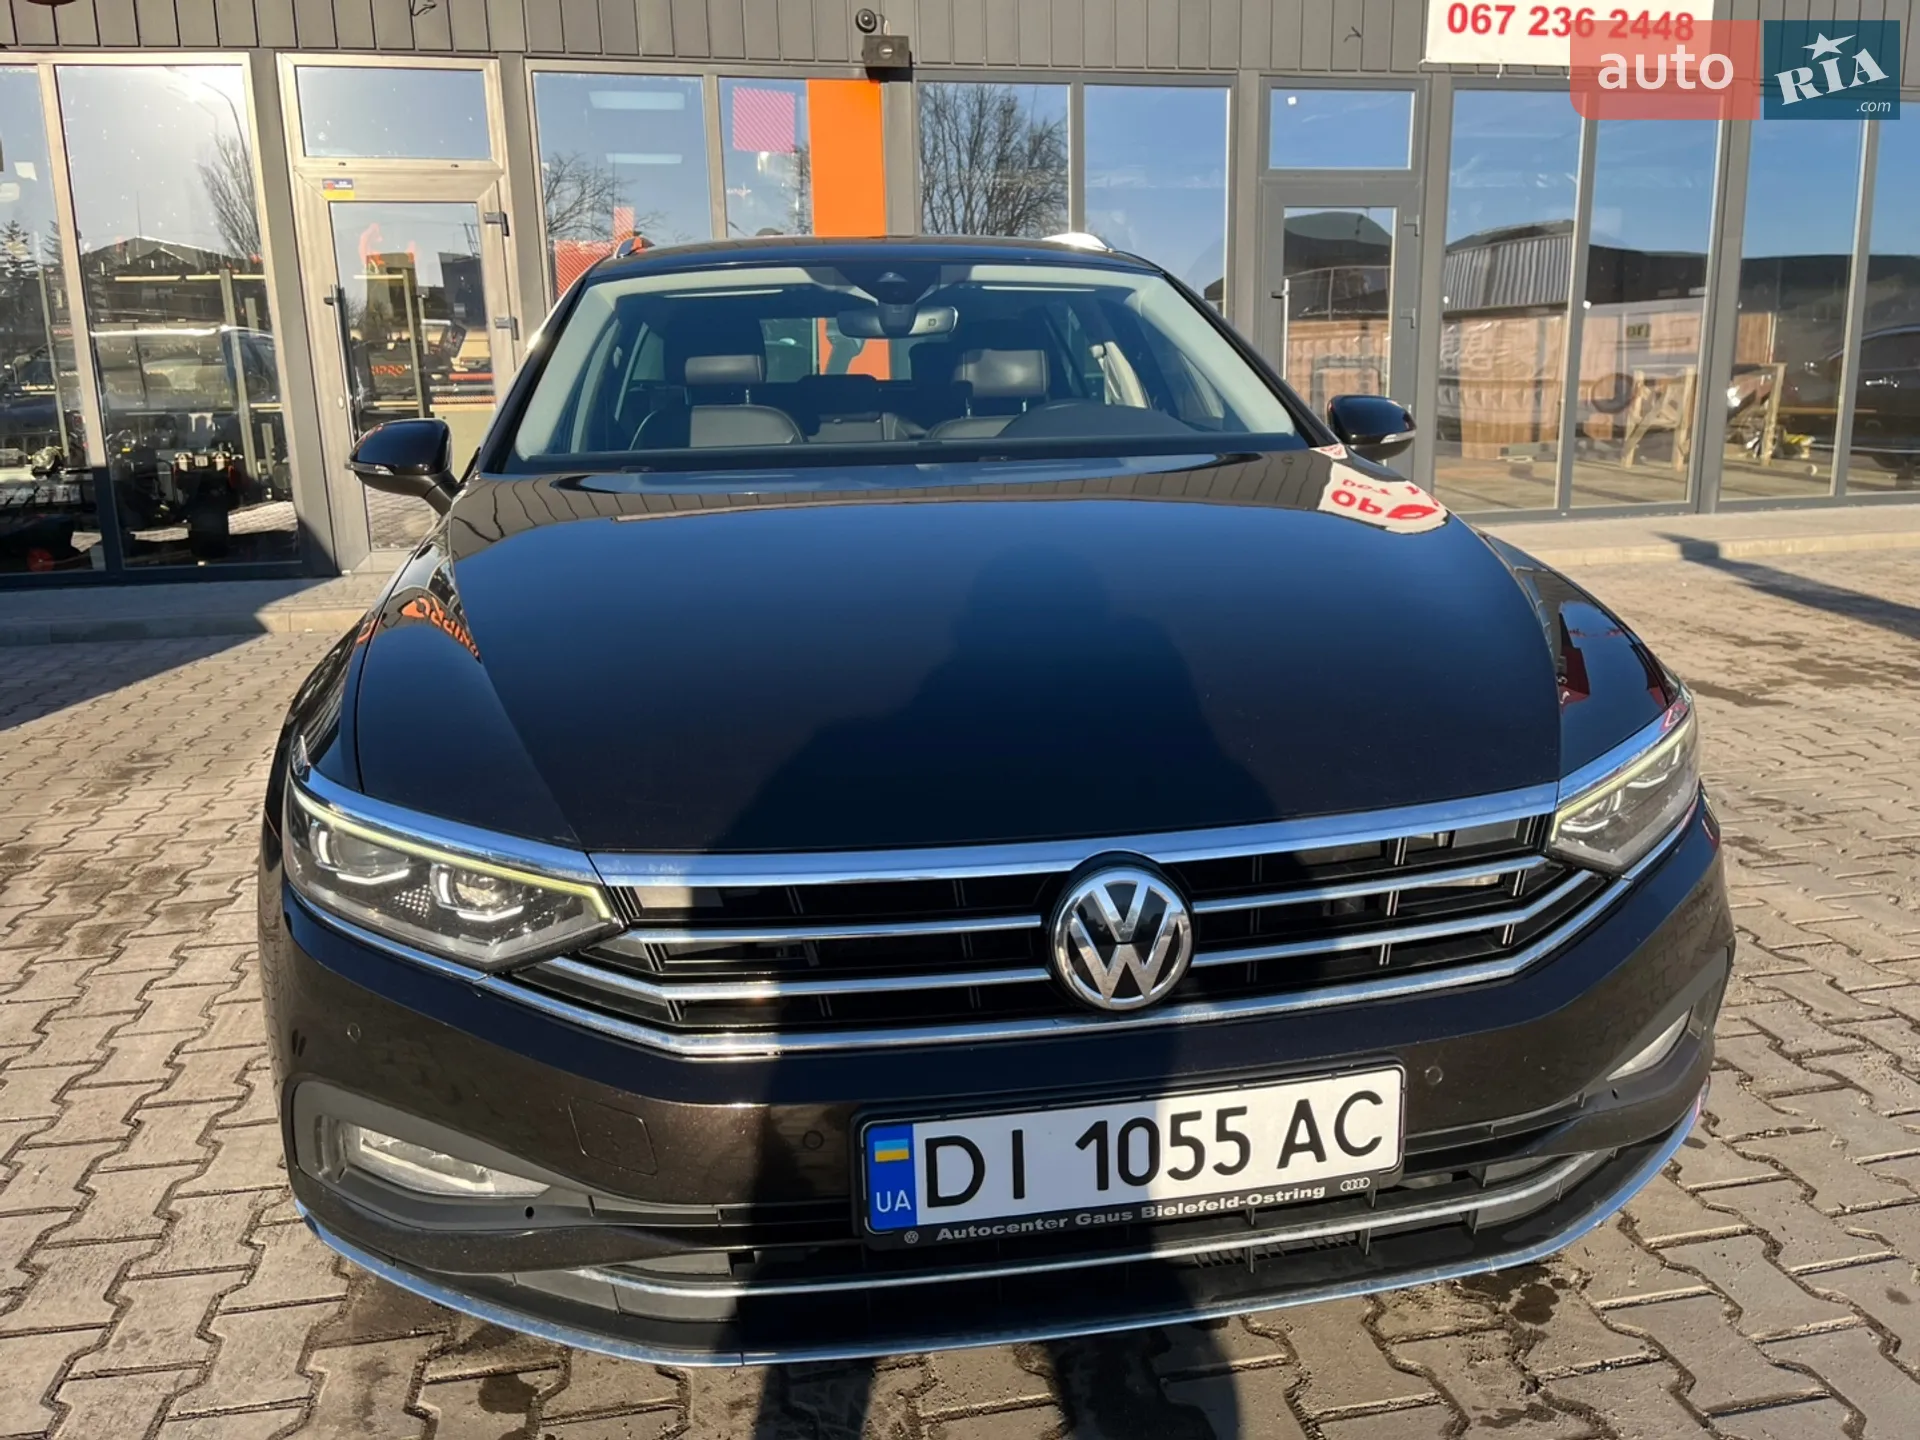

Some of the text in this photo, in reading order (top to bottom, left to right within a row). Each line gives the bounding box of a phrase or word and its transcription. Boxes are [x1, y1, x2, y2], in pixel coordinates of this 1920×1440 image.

[1447, 3, 1695, 41] 067 236 2448
[924, 1090, 1383, 1209] DI 1055 AC
[876, 1189, 912, 1213] UA
[936, 1186, 1325, 1241] Autocenter Gaus Bielefeld-Ostring
